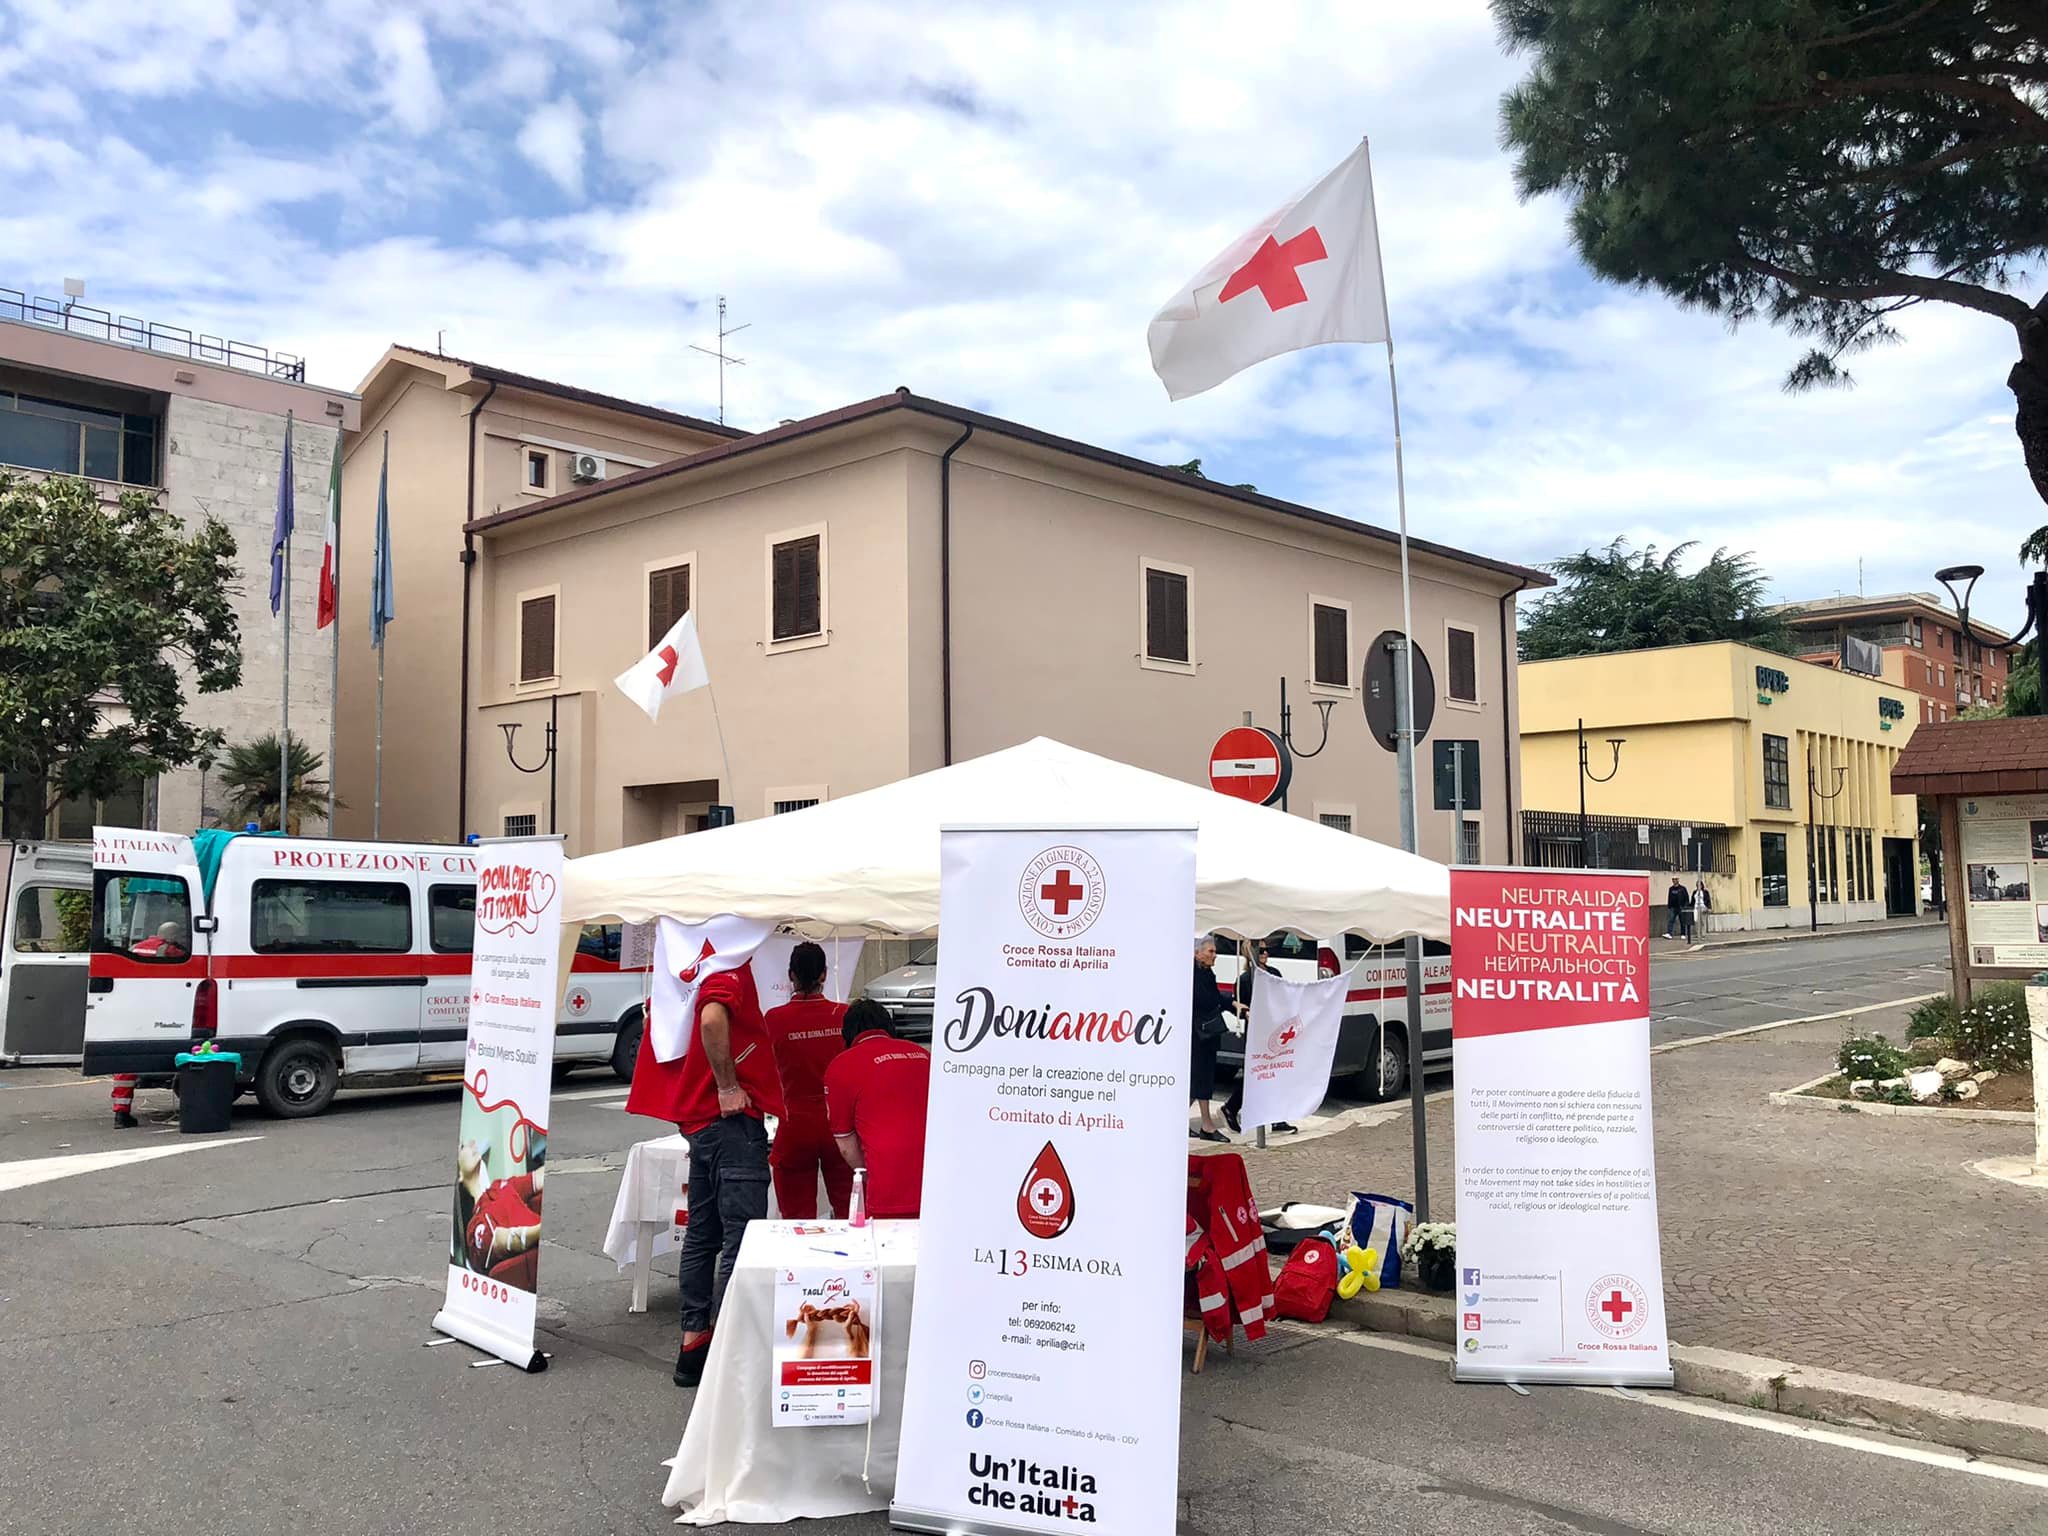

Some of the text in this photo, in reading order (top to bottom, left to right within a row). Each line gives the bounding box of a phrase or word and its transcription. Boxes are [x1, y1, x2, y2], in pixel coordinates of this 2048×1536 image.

[114, 840, 177, 854] ITALIANA
[274, 851, 430, 871] PROTEZIONE
[482, 865, 532, 892] DONA CHE
[1022, 849, 1103, 935] CONVENZIONE DI GINEVRA 22 AGOSTO 1864
[1502, 888, 1644, 908] NEUTRALIDAD
[483, 893, 527, 920] TI TORNA
[1456, 906, 1626, 932] NEUTRALITÉ
[1002, 944, 1116, 958] Croce Rossa Italiana
[1497, 932, 1646, 956] NEUTRALITY
[1006, 956, 1109, 970] Comitato di Aprilia
[1484, 954, 1636, 975] НЕЙТРАЛЬНОСТЬ
[1457, 977, 1640, 1002] NEUTRALITÀ
[427, 996, 458, 1005] CROCE
[485, 993, 542, 1008] Croce Rossa Italiana
[944, 987, 1172, 1053] Doniamoci
[478, 1043, 494, 1057] Bristol
[496, 1046, 514, 1062] Myers
[943, 1060, 1176, 1089] Campagna per la creazione del gruppo
[997, 1082, 1116, 1102] donatori sangue nel
[1472, 1088, 1484, 1096] Per
[1486, 1090, 1507, 1098] poter
[1558, 1090, 1586, 1100] godere
[1608, 1090, 1632, 1099] fiducia
[1470, 1100, 1490, 1108] tutti,
[1568, 1101, 1595, 1109] schiera
[988, 1106, 1124, 1132] Comitato di Aprilia
[1500, 1112, 1519, 1120] parti
[1529, 1112, 1564, 1121] conflitto,
[1566, 1112, 1576, 1120] né
[1578, 1113, 1606, 1122] prende
[1607, 1114, 1628, 1122] parte
[1573, 1124, 1604, 1133] politico,
[1606, 1125, 1638, 1134] razziale,
[1516, 1135, 1548, 1144] religioso
[1556, 1135, 1599, 1146] ideologico.
[1552, 1168, 1572, 1177] enjoy
[1589, 1168, 1632, 1178] confidence
[1523, 1180, 1539, 1188] may
[1465, 1191, 1494, 1200] engage
[1506, 1192, 1519, 1200] any
[1549, 1191, 1601, 1199] controversies
[1620, 1192, 1650, 1200] political,
[1489, 1202, 1512, 1211] racial,
[1514, 1202, 1546, 1212] religious
[1558, 1202, 1600, 1213] ideological
[974, 1248, 994, 1264] LA
[1087, 1259, 1122, 1276] ORA
[1022, 1301, 1062, 1314] per info:
[1008, 1317, 1076, 1333] tel: 0692062142
[1002, 1334, 1085, 1352] e-mail: aprilia@cri.it
[1602, 1343, 1628, 1351] Rossa
[984, 1417, 1004, 1426] Croce
[1005, 1420, 1024, 1430] Rossa
[1026, 1424, 1050, 1433] Italiana
[1056, 1427, 1086, 1438] Comitato
[1086, 1430, 1093, 1438] di
[1094, 1432, 1115, 1442] Aprilia
[968, 1482, 1096, 1522] che aiuta
